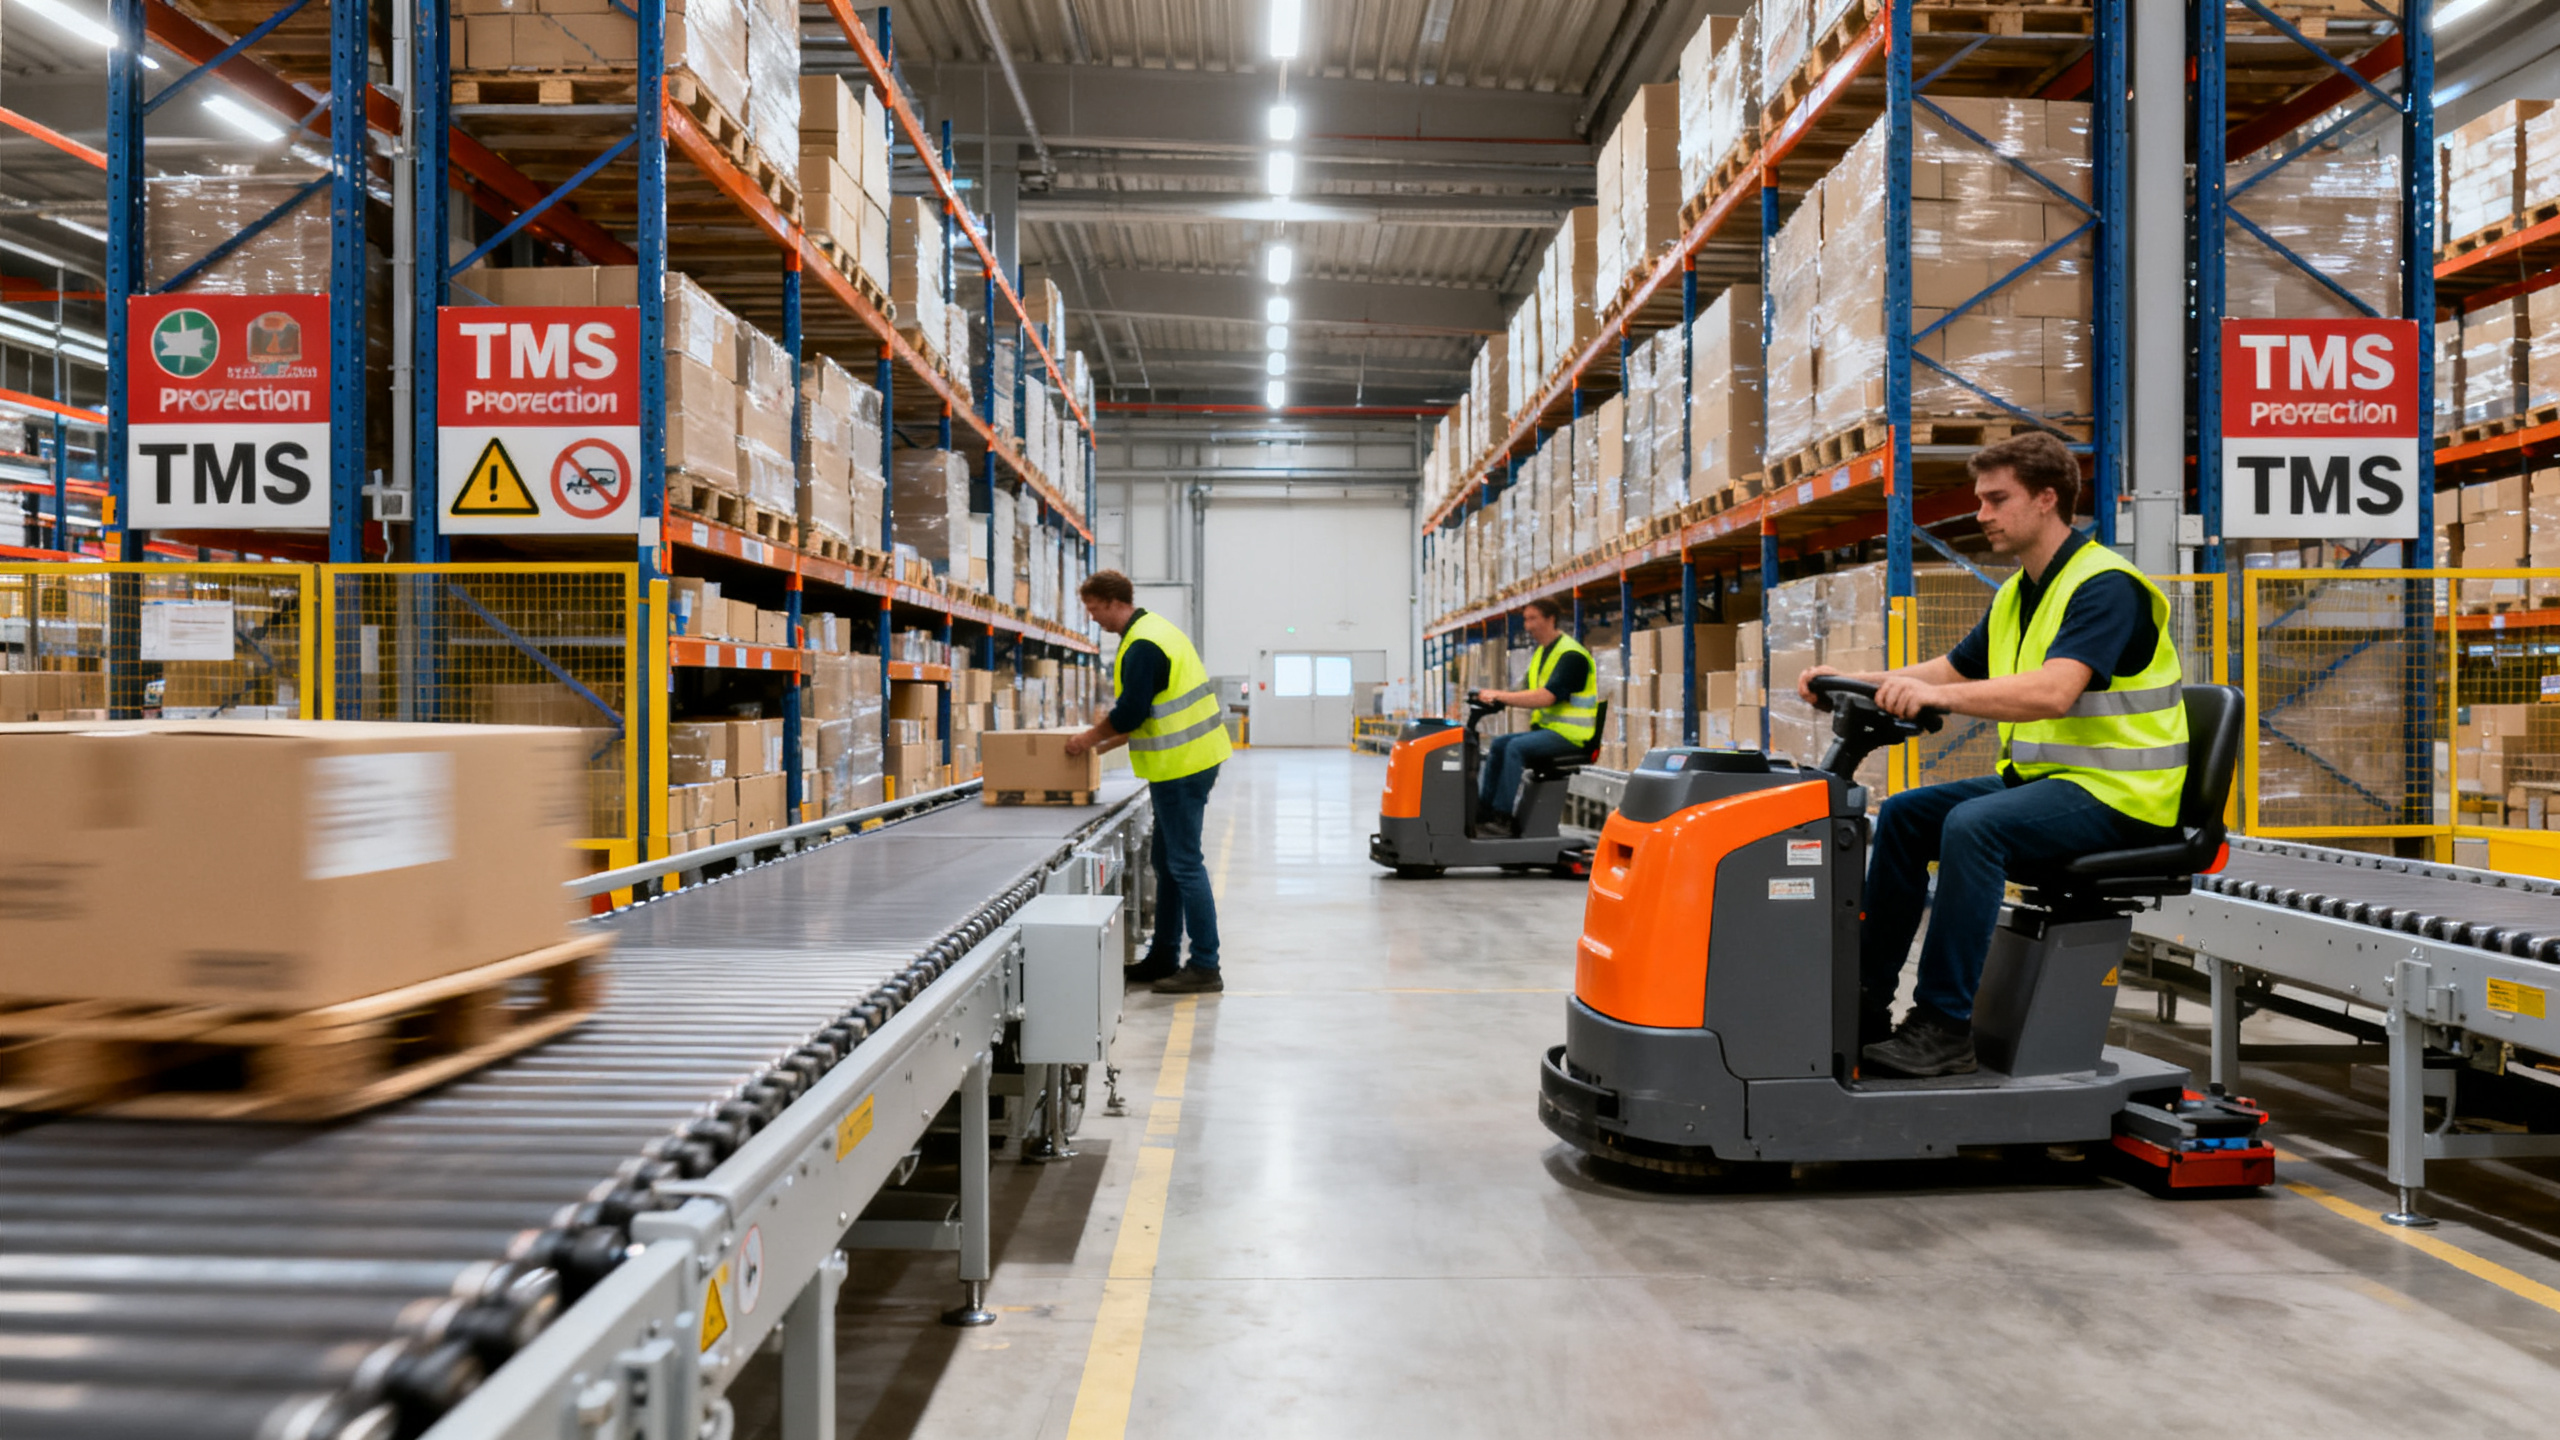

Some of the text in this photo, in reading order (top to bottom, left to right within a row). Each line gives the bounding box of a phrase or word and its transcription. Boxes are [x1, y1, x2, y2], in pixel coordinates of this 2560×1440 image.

[459, 322, 618, 379] TMS
[2239, 334, 2395, 390] TMS
[138, 441, 312, 505] TMS
[2237, 455, 2404, 516] TMS
